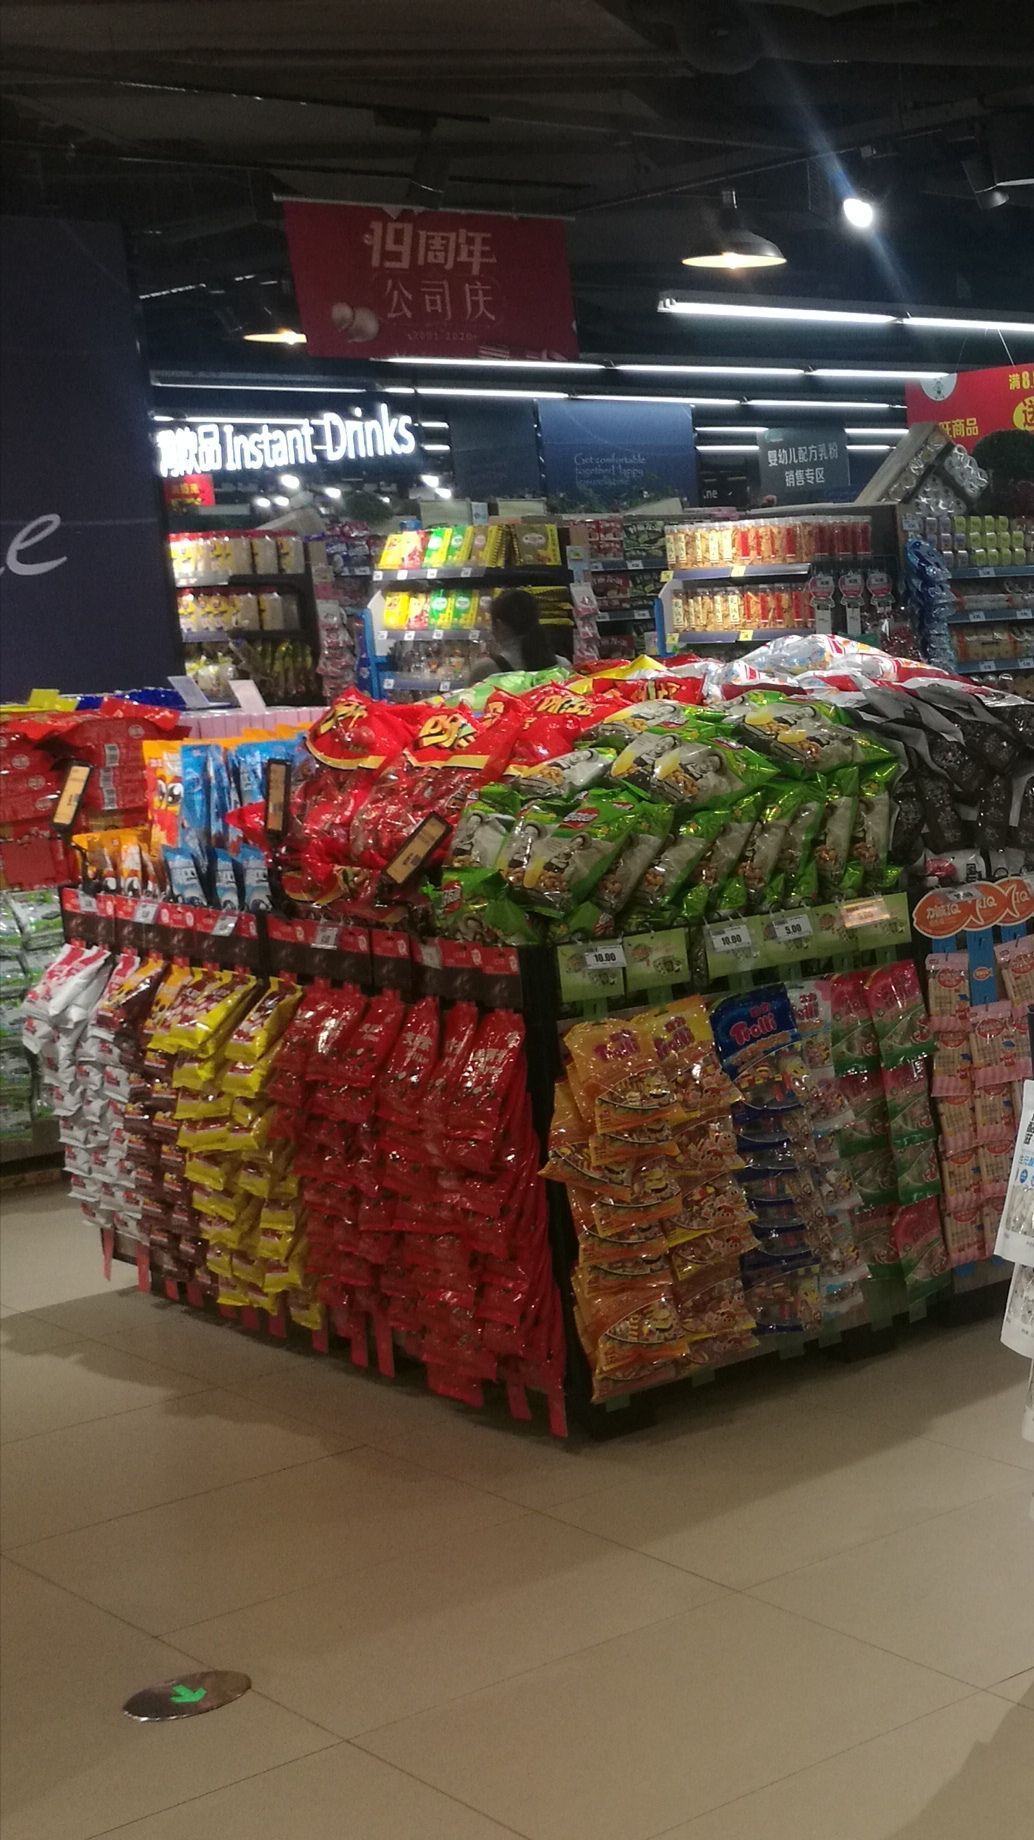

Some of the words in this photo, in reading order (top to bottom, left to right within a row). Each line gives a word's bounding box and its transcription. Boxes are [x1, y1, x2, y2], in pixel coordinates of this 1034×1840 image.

[363, 221, 497, 275] 19周年
[386, 279, 496, 321] 公司庆
[223, 420, 318, 471] Instant
[322, 404, 416, 462] Drinks
[767, 442, 839, 467] 婴幼儿配方乳粉
[785, 467, 825, 487] 销售专区
[721, 933, 742, 946] 10.00
[785, 923, 802, 936] 5.00
[594, 951, 617, 963] 10.00
[729, 1012, 778, 1046] Trolli
